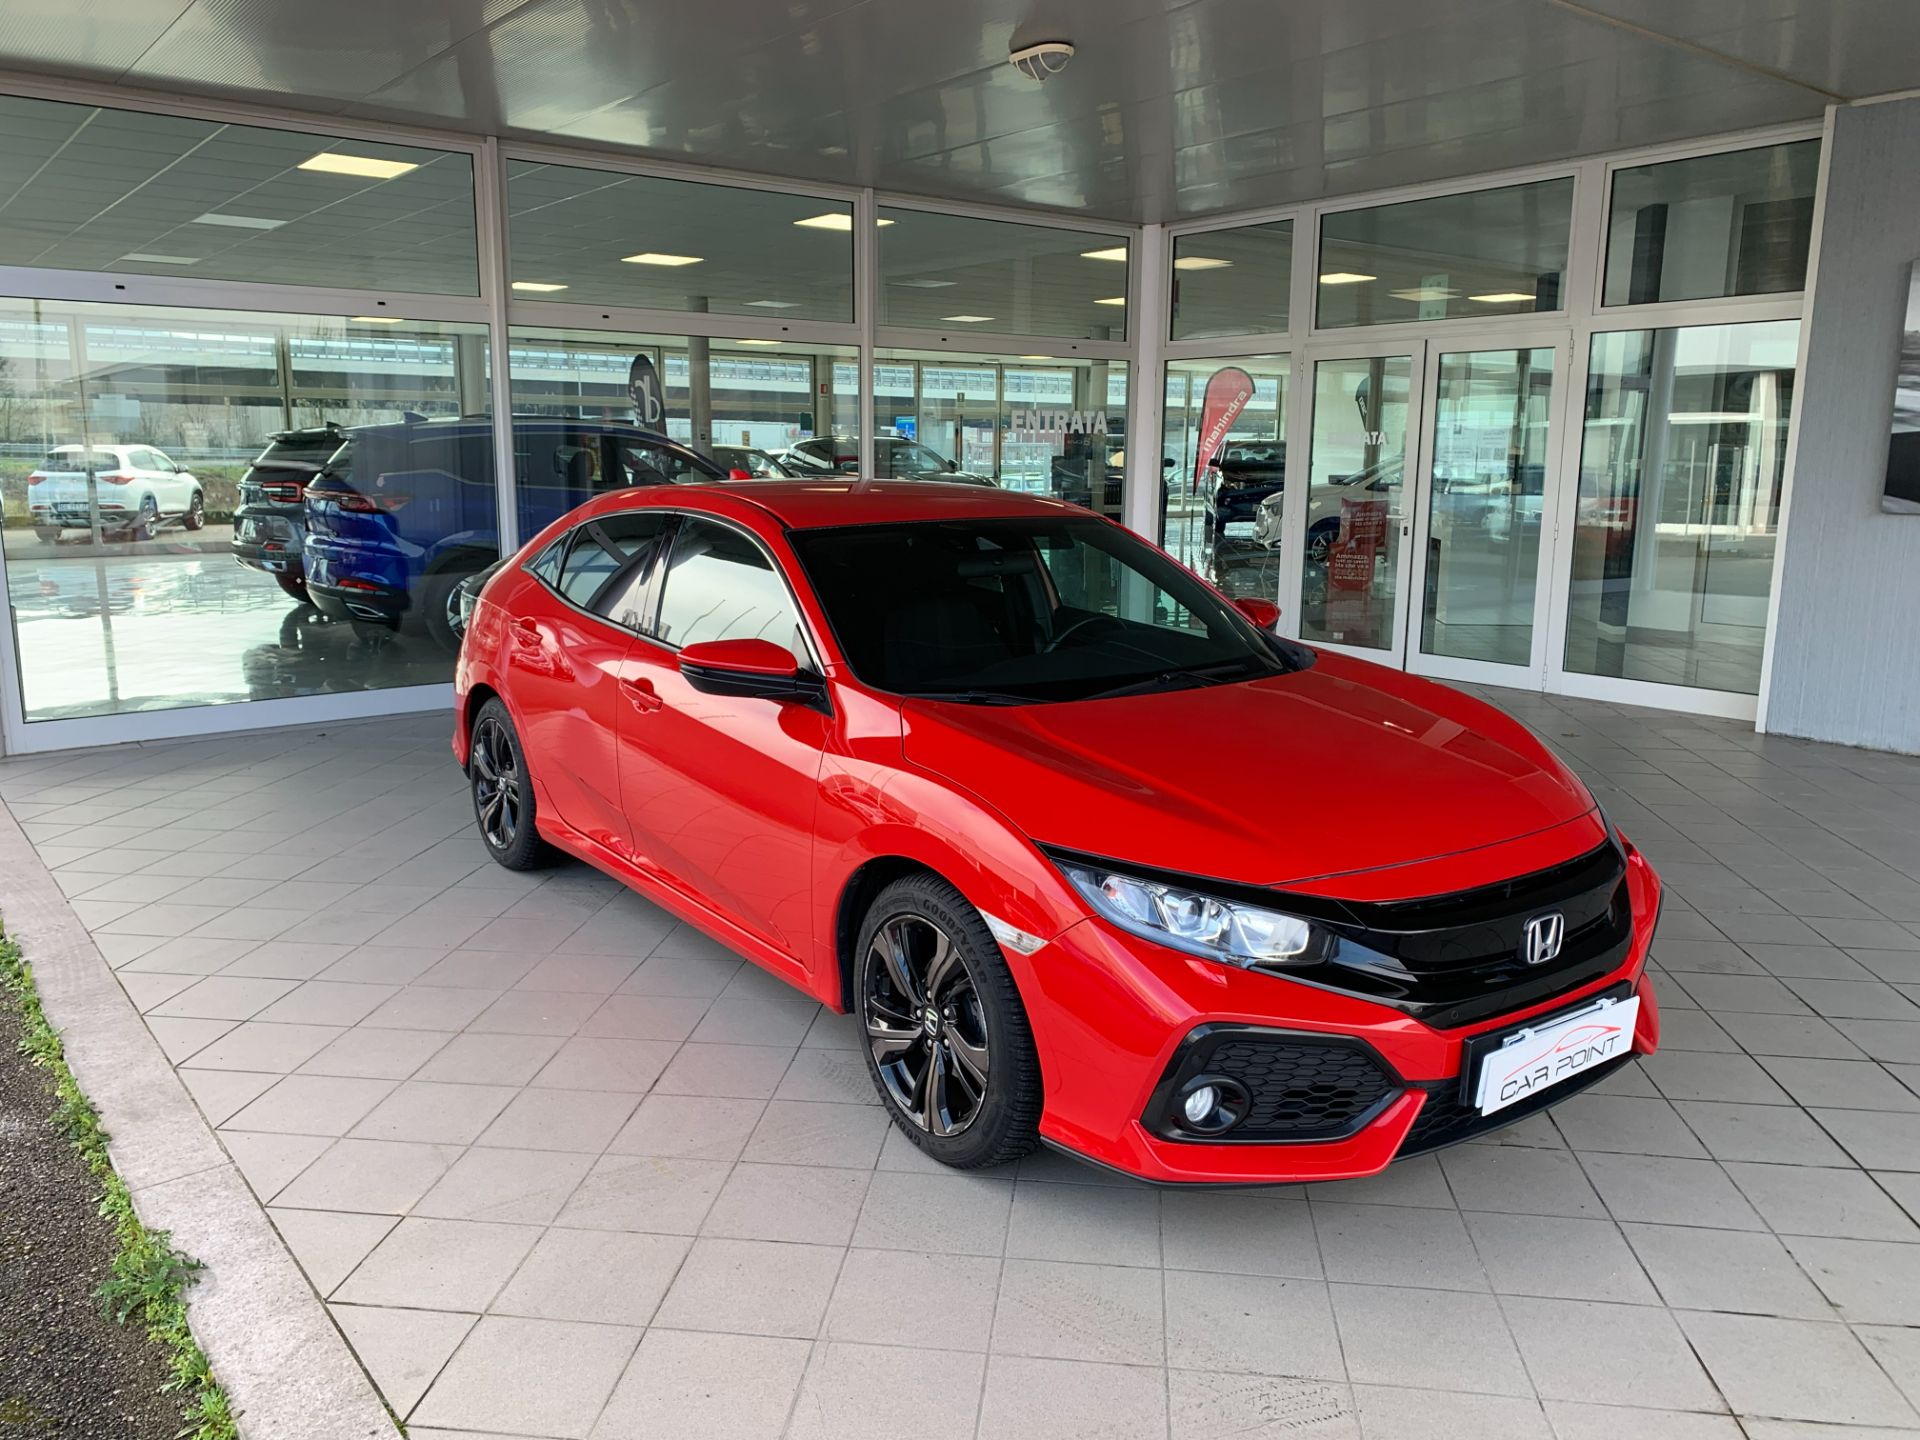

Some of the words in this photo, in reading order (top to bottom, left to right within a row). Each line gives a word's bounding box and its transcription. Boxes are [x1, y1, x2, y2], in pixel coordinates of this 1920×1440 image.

[1011, 410, 1108, 434] ENTRATA
[1203, 391, 1247, 452] mahindra
[923, 899, 987, 983] GOODYEAR
[1500, 1066, 1549, 1101] CAR
[1556, 1035, 1620, 1076] POINT
